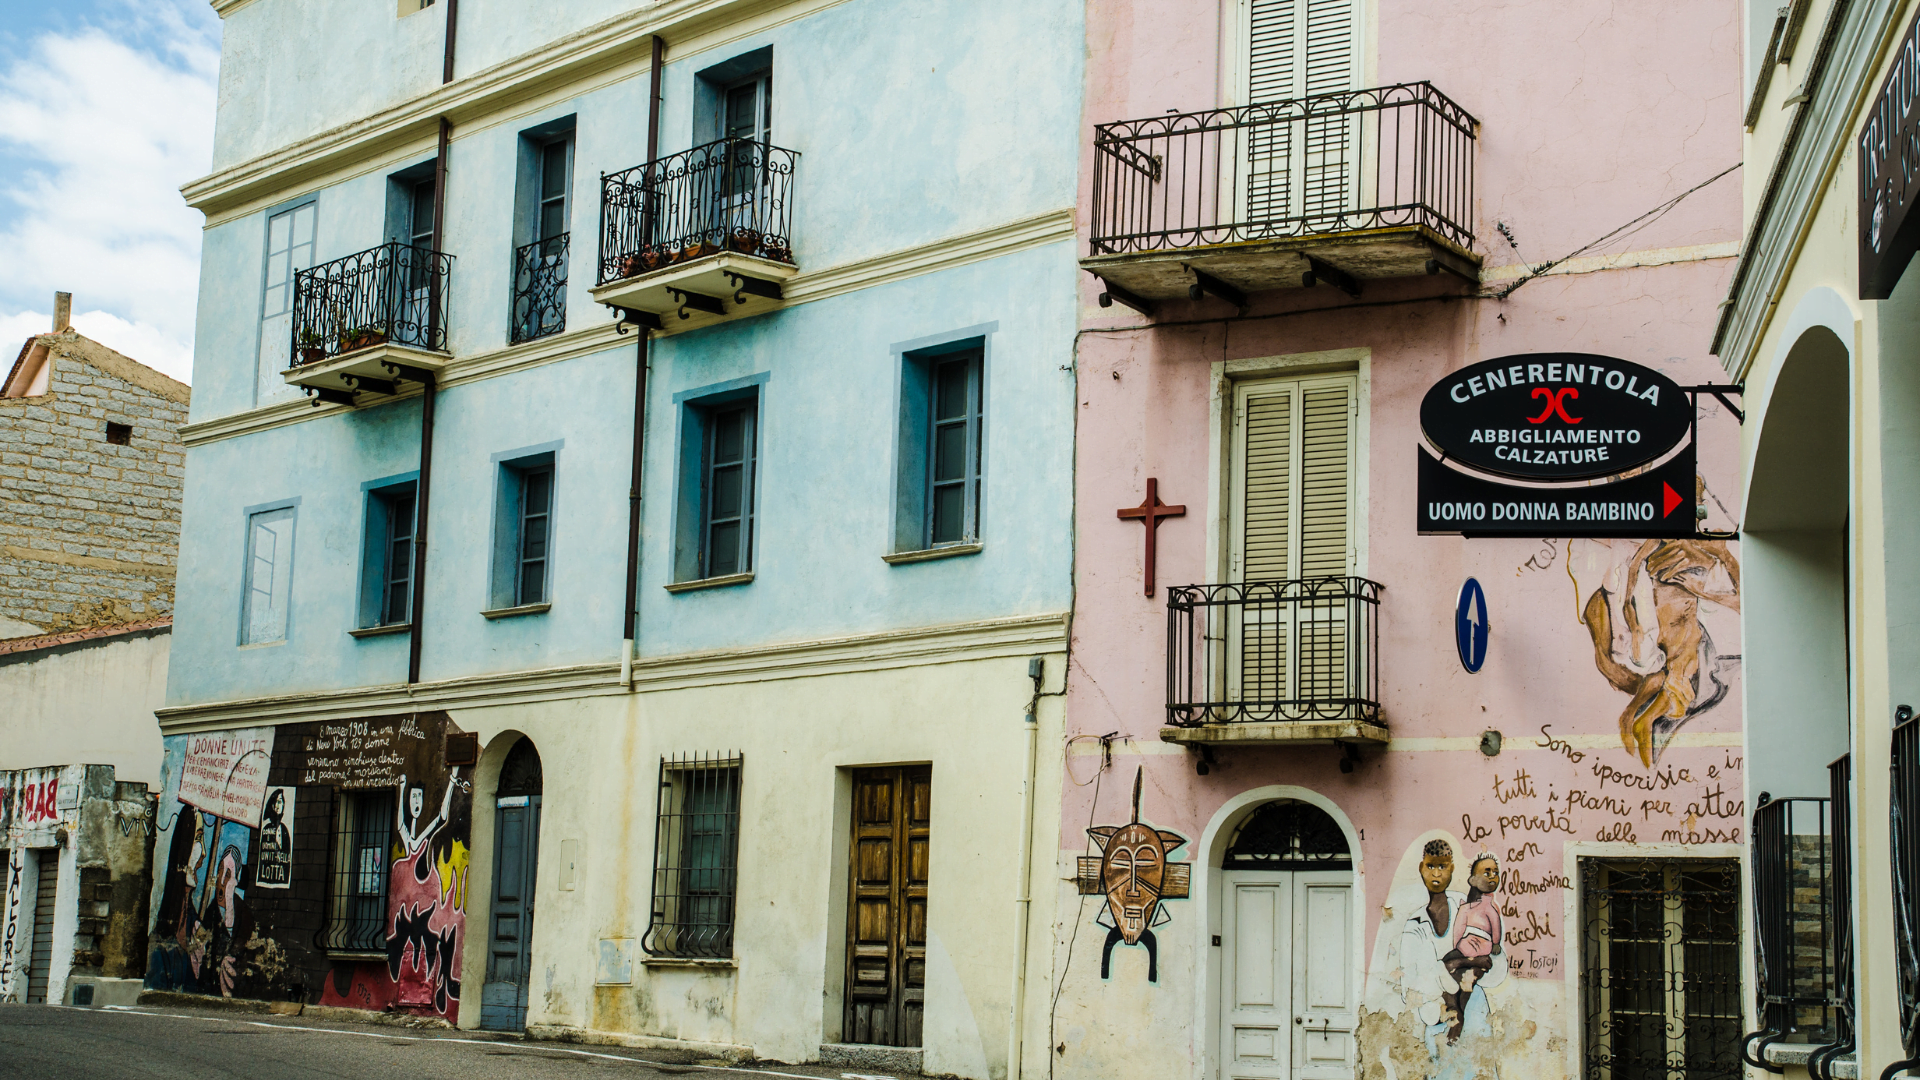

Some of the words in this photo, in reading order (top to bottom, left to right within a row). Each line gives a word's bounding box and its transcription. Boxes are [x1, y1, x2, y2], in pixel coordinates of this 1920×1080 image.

[1450, 362, 1660, 406] CENERENTOLA
[1469, 429, 1641, 444] ABBIGLIAMENTO
[1494, 445, 1610, 465] CALZATURE
[1428, 501, 1486, 521] UOMO
[1492, 501, 1561, 521] DONNA
[1565, 501, 1655, 521] BAMBINO
[349, 721, 369, 737] 1908
[370, 726, 378, 737] in
[194, 738, 227, 755] DONNE
[231, 739, 266, 759] UNITE
[316, 739, 331, 751] New
[350, 737, 363, 750] 129
[364, 737, 390, 750] donne
[378, 749, 405, 765] dentro
[1535, 724, 1586, 763] Sono
[1592, 757, 1699, 791] ipocrisia
[1706, 765, 1720, 779] e
[1492, 767, 1537, 804] tutti
[1548, 783, 1559, 802] i
[1565, 789, 1632, 817] piani
[1640, 799, 1672, 821] per
[1359, 828, 1366, 841] 1
[1461, 813, 1492, 843] la
[1596, 822, 1637, 845] delle
[1661, 827, 1740, 845] masse
[1506, 842, 1545, 862] con
[261, 864, 285, 881] LOTTA
[1499, 867, 1574, 896] l'elemosina
[1501, 896, 1520, 919] dei
[1505, 910, 1556, 946] ricchi
